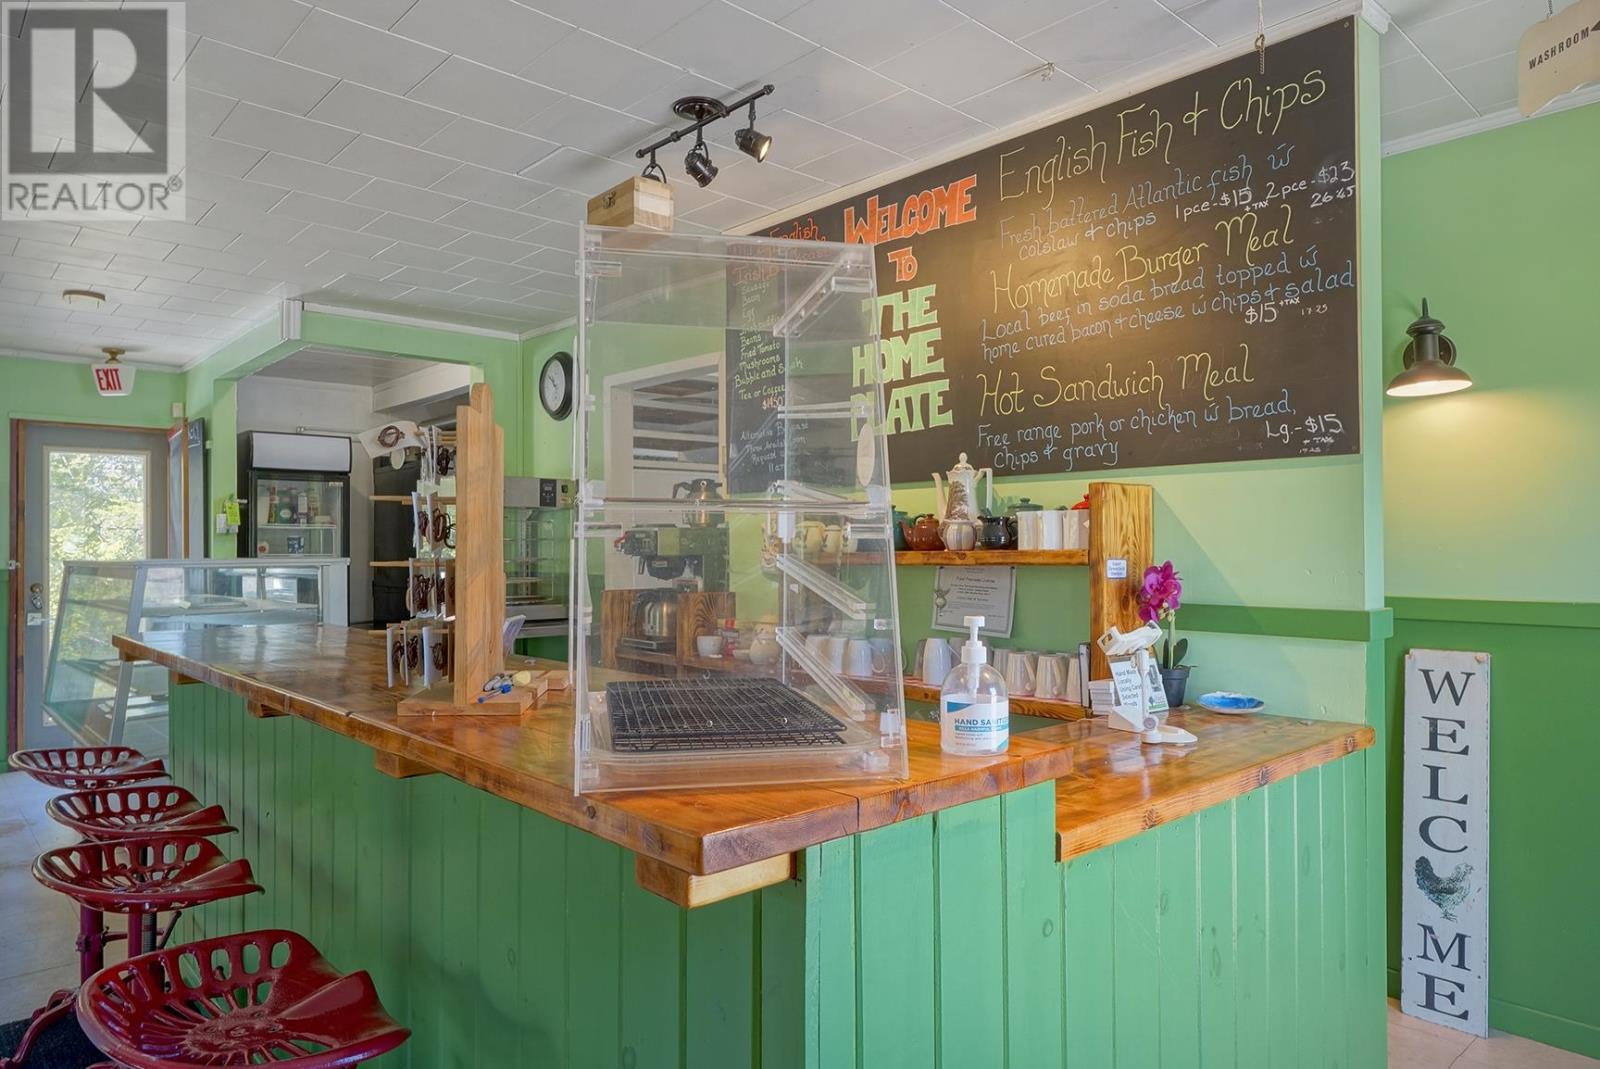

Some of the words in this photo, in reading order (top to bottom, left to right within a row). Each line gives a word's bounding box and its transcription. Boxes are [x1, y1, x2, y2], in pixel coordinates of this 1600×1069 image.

[1528, 26, 1589, 70] WASHROOM
[1000, 125, 1106, 210] English
[1117, 103, 1173, 165] Fish
[1220, 69, 1326, 135] Chips
[843, 174, 977, 246] WELCOME
[1000, 213, 1043, 249] Fresh
[1046, 192, 1118, 237] battered
[1122, 168, 1203, 214] Atlantic
[1207, 154, 1253, 201] fish
[1105, 211, 1157, 240] chips
[990, 255, 1114, 313] Homemade
[1115, 243, 1208, 290] Burger
[1214, 204, 1295, 267] Meal
[862, 283, 938, 336] THE
[981, 309, 1031, 342] Local
[1038, 306, 1071, 326] beef
[1077, 301, 1093, 315] in
[1099, 285, 1144, 311] soda
[1150, 267, 1206, 299] bread
[1215, 250, 1291, 285] topped
[981, 342, 1021, 364] home
[1025, 325, 1067, 351] cured
[1070, 318, 1114, 343] bacon
[1129, 308, 1186, 330] cheese
[1211, 289, 1262, 314] chips
[1284, 260, 1356, 299] salad
[1244, 301, 1277, 325] $15
[95, 367, 122, 391] EXIT
[852, 327, 945, 388] HOME
[975, 367, 1025, 417] Hot
[1034, 360, 1168, 412] Sandwich
[1176, 343, 1255, 402] Meal
[851, 378, 954, 443] PLATE
[976, 422, 1010, 449] Free
[1016, 424, 1063, 443] range
[1070, 412, 1105, 446] pork
[1109, 416, 1126, 432] or
[1130, 406, 1197, 438] chicken
[994, 443, 1039, 471] chips
[1063, 440, 1119, 472] gravy
[954, 717, 979, 726] HAND
